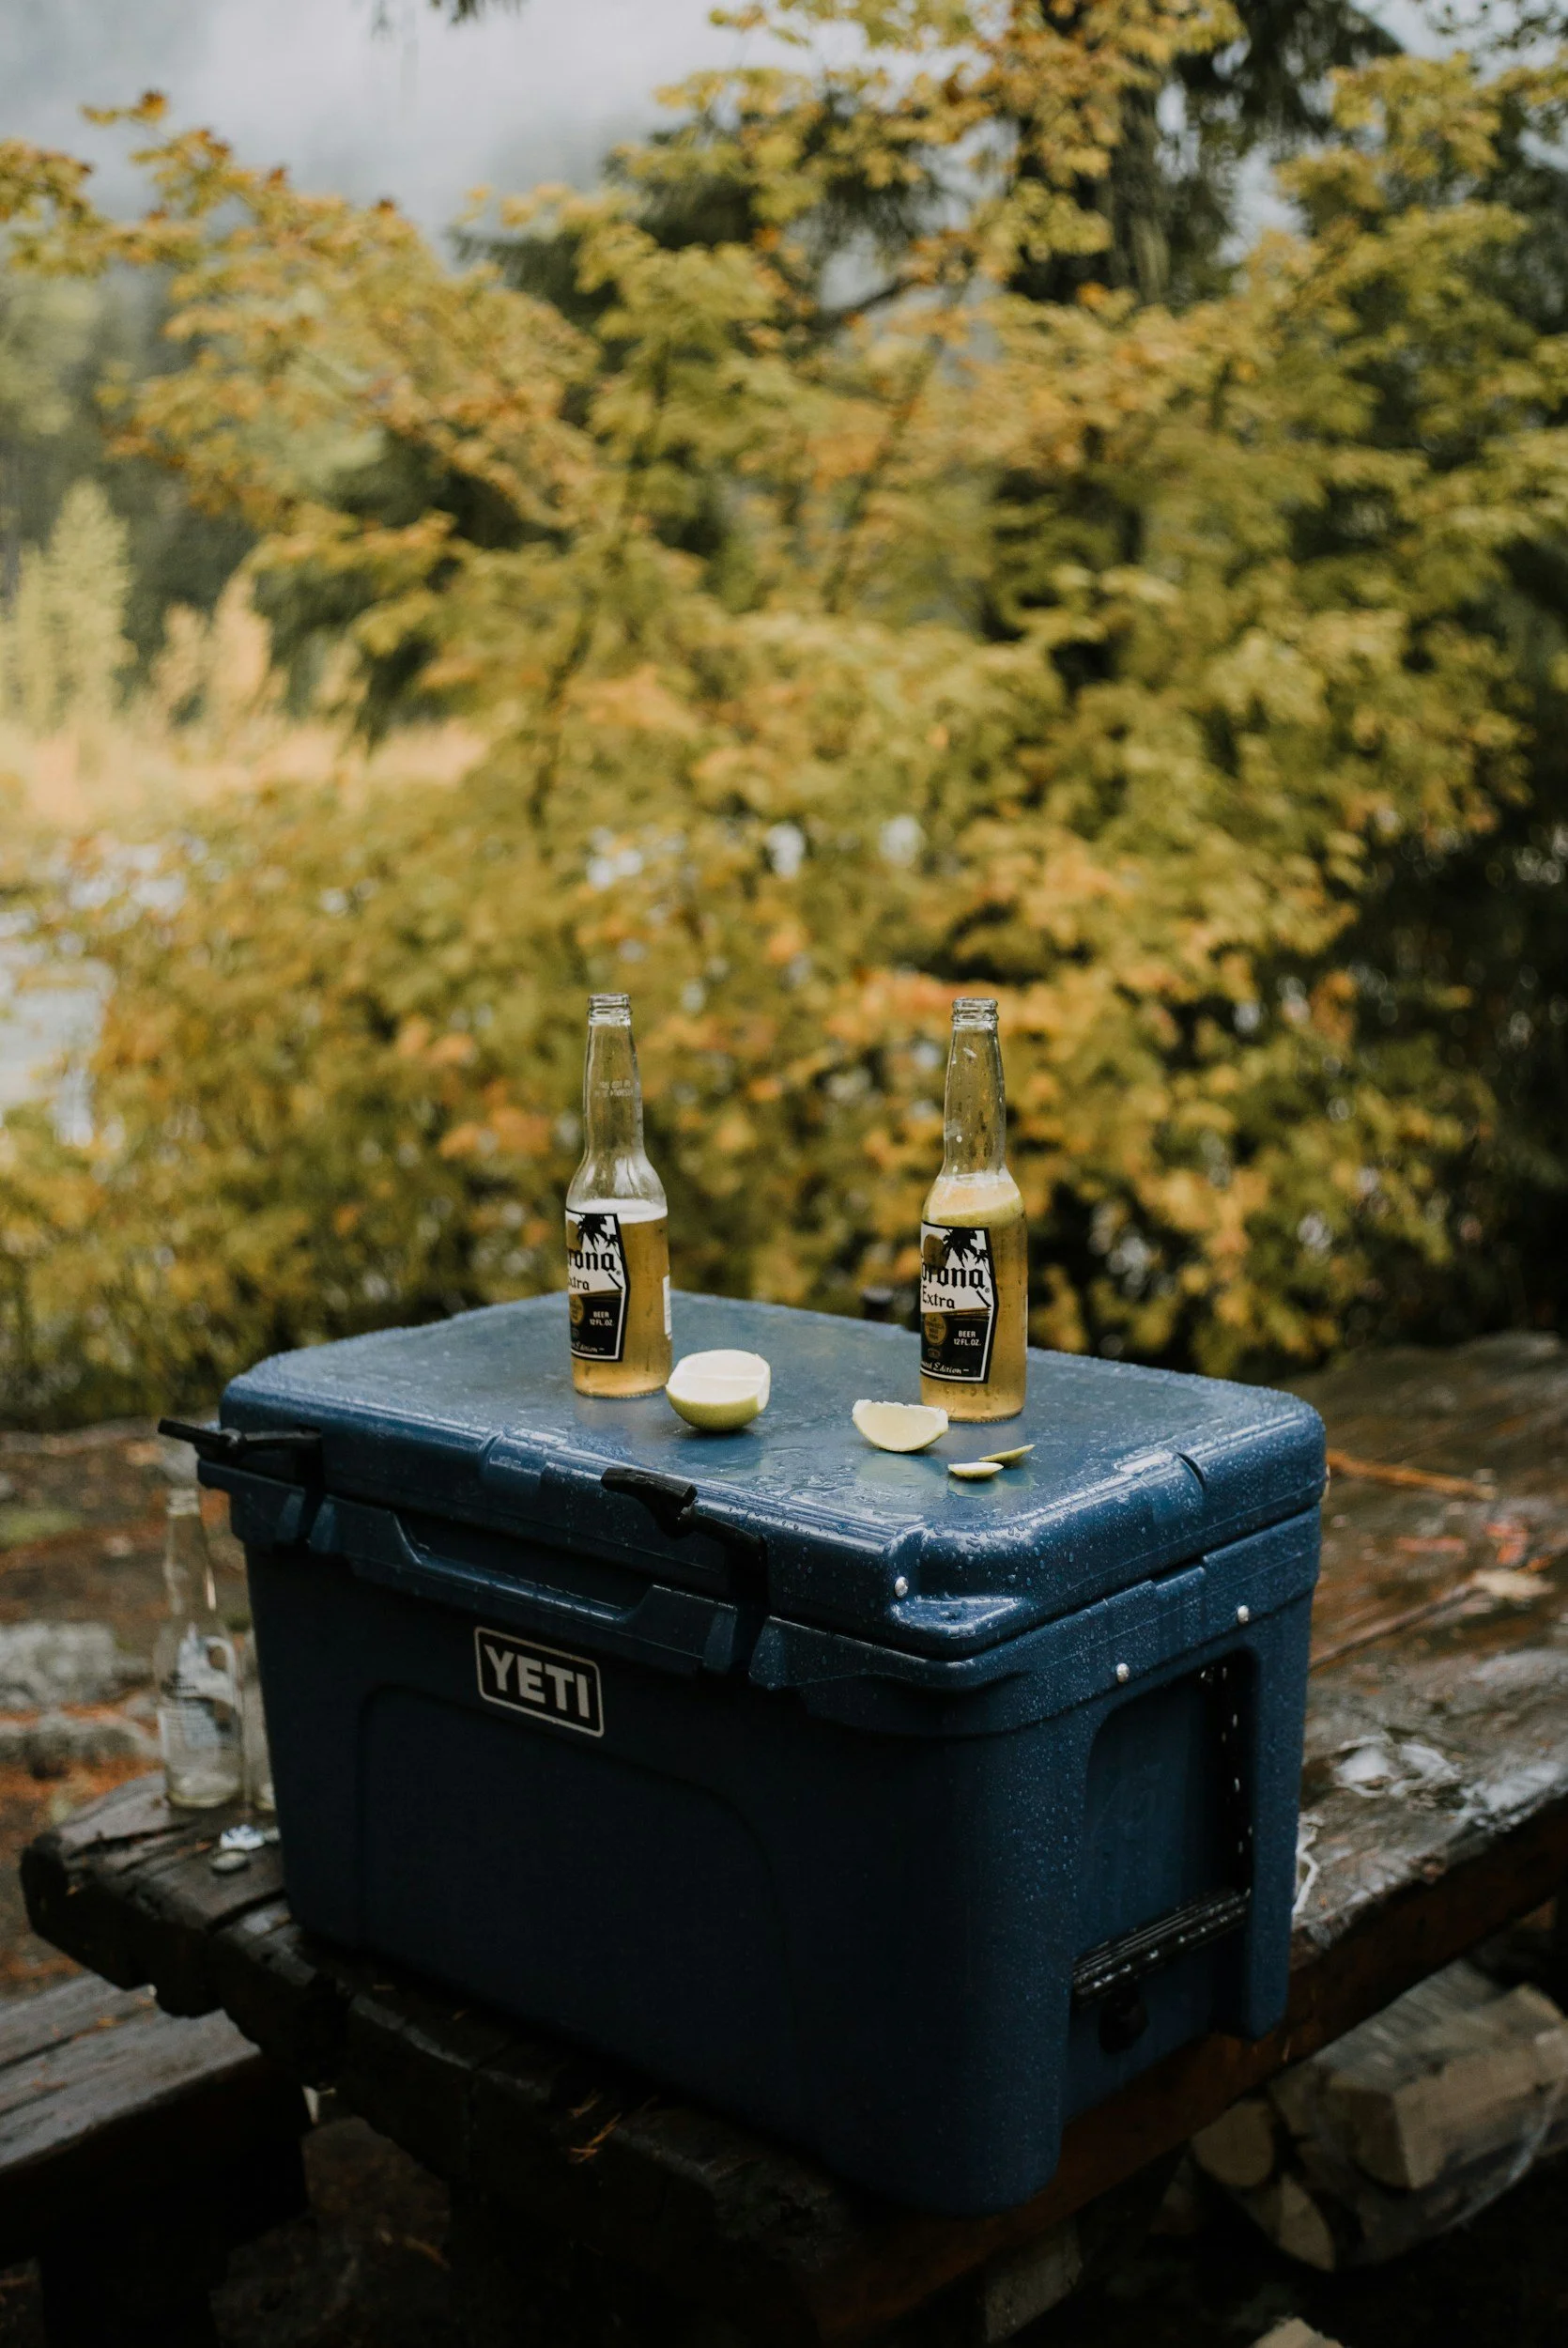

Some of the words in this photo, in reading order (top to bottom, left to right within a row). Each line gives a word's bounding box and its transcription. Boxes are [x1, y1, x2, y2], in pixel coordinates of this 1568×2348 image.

[569, 1249, 616, 1272] rona
[569, 1276, 590, 1290] xtra
[922, 1262, 985, 1290] orona
[923, 1285, 955, 1308] Extra
[958, 1330, 976, 1338] BEER
[484, 1644, 591, 1719] YETI
